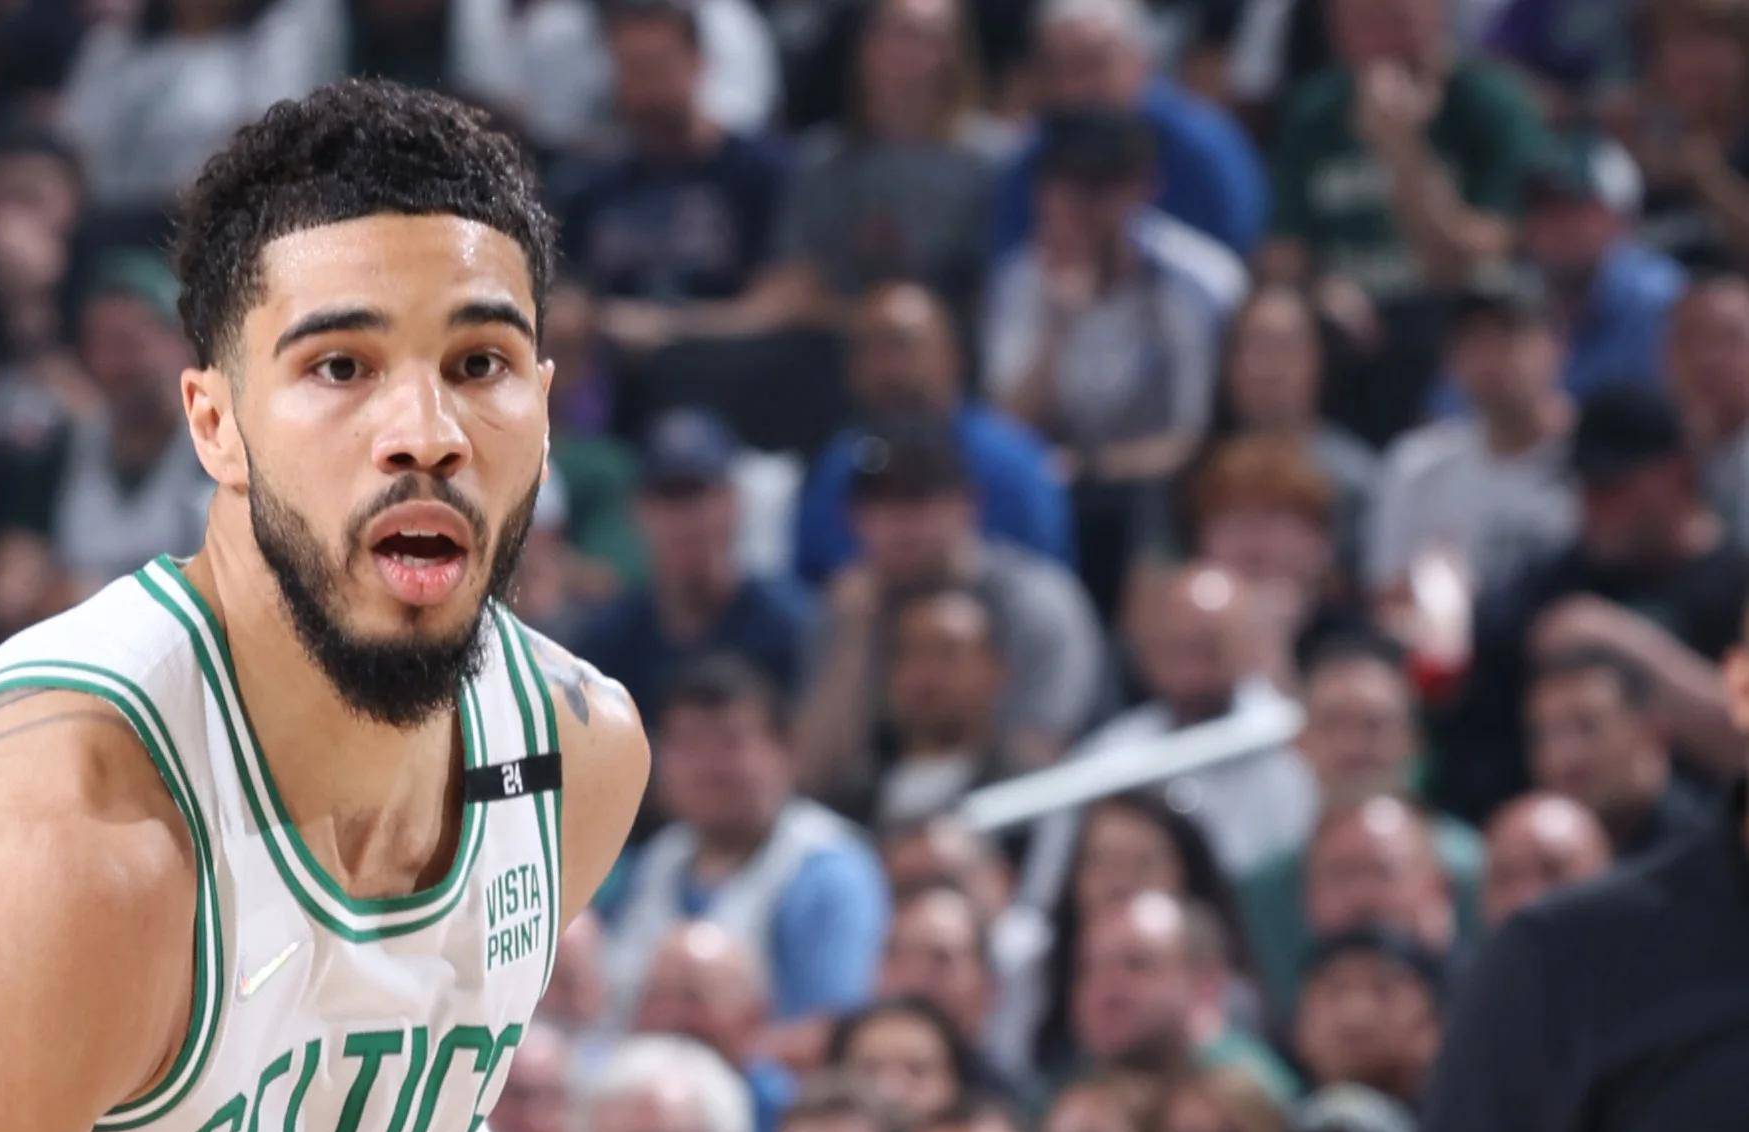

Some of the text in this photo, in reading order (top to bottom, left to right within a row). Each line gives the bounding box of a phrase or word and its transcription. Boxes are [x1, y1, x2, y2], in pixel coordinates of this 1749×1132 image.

[501, 761, 524, 796] 24
[485, 863, 542, 930] VISTA
[486, 915, 542, 971] PRINT
